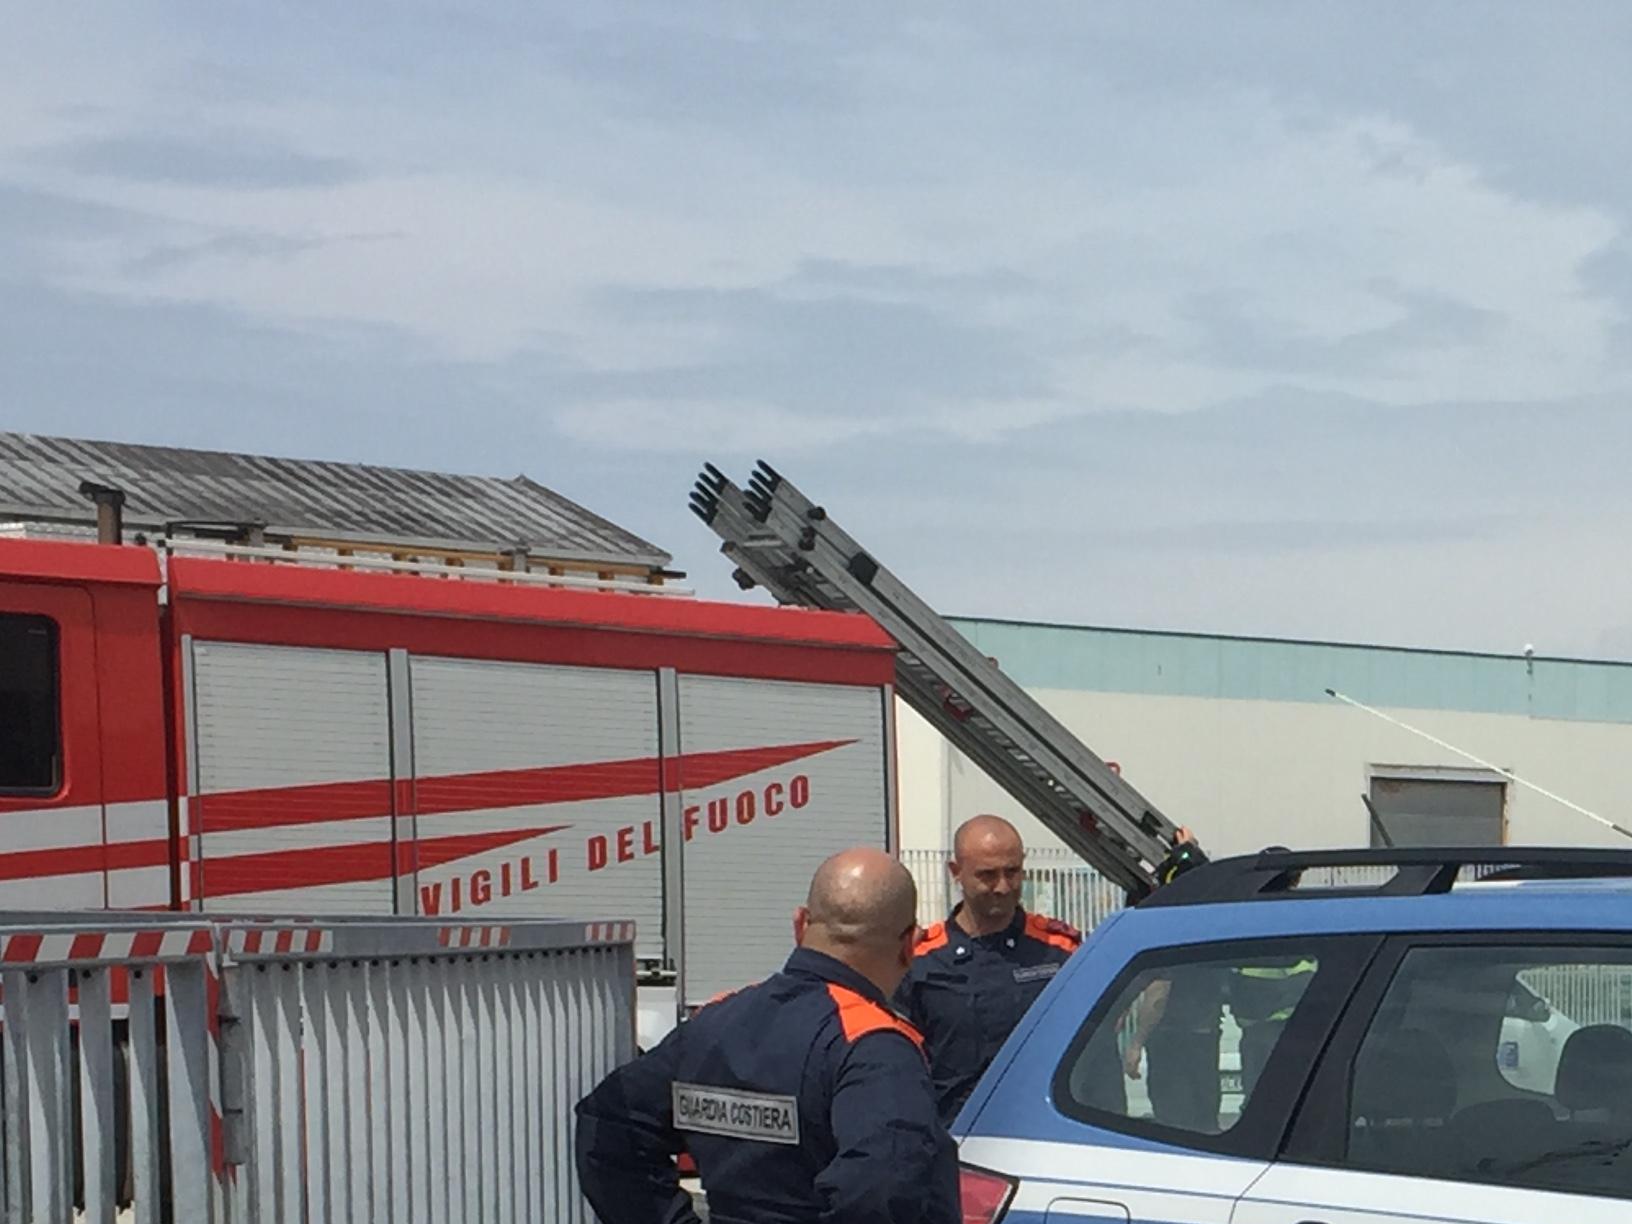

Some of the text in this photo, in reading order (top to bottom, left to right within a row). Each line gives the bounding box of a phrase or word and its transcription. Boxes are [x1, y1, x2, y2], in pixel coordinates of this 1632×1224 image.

[421, 774, 810, 917] VIGILI DEL FUOCO
[679, 1095, 792, 1131] GUARDIA COSTIERA
